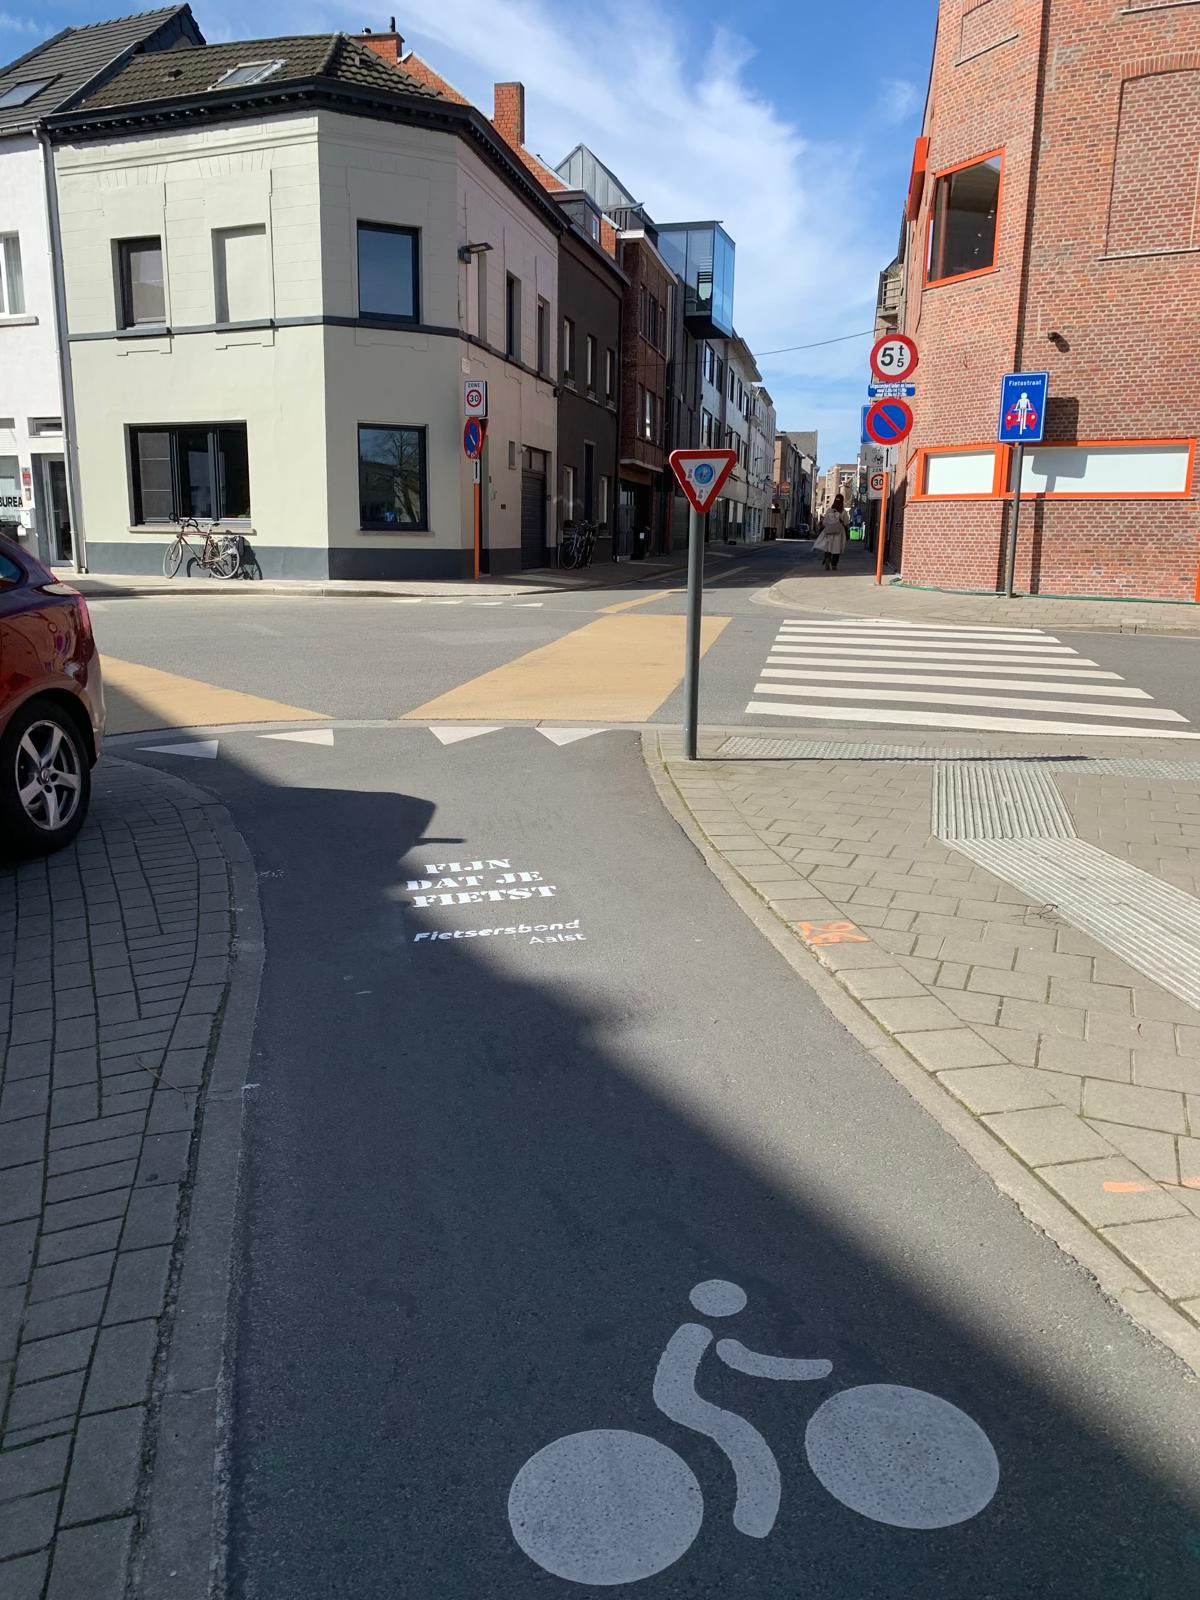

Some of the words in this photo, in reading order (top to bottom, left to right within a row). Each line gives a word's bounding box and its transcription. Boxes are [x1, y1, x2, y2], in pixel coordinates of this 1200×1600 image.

[881, 347, 894, 367] 5
[470, 394, 479, 402] 30
[873, 478, 884, 487] 30
[424, 859, 511, 874] FIJN
[406, 875, 484, 891] DAT
[496, 871, 543, 884] JE
[412, 885, 557, 907] FIETST
[413, 919, 580, 942] Fietsersbond
[529, 932, 586, 945] Aalst
